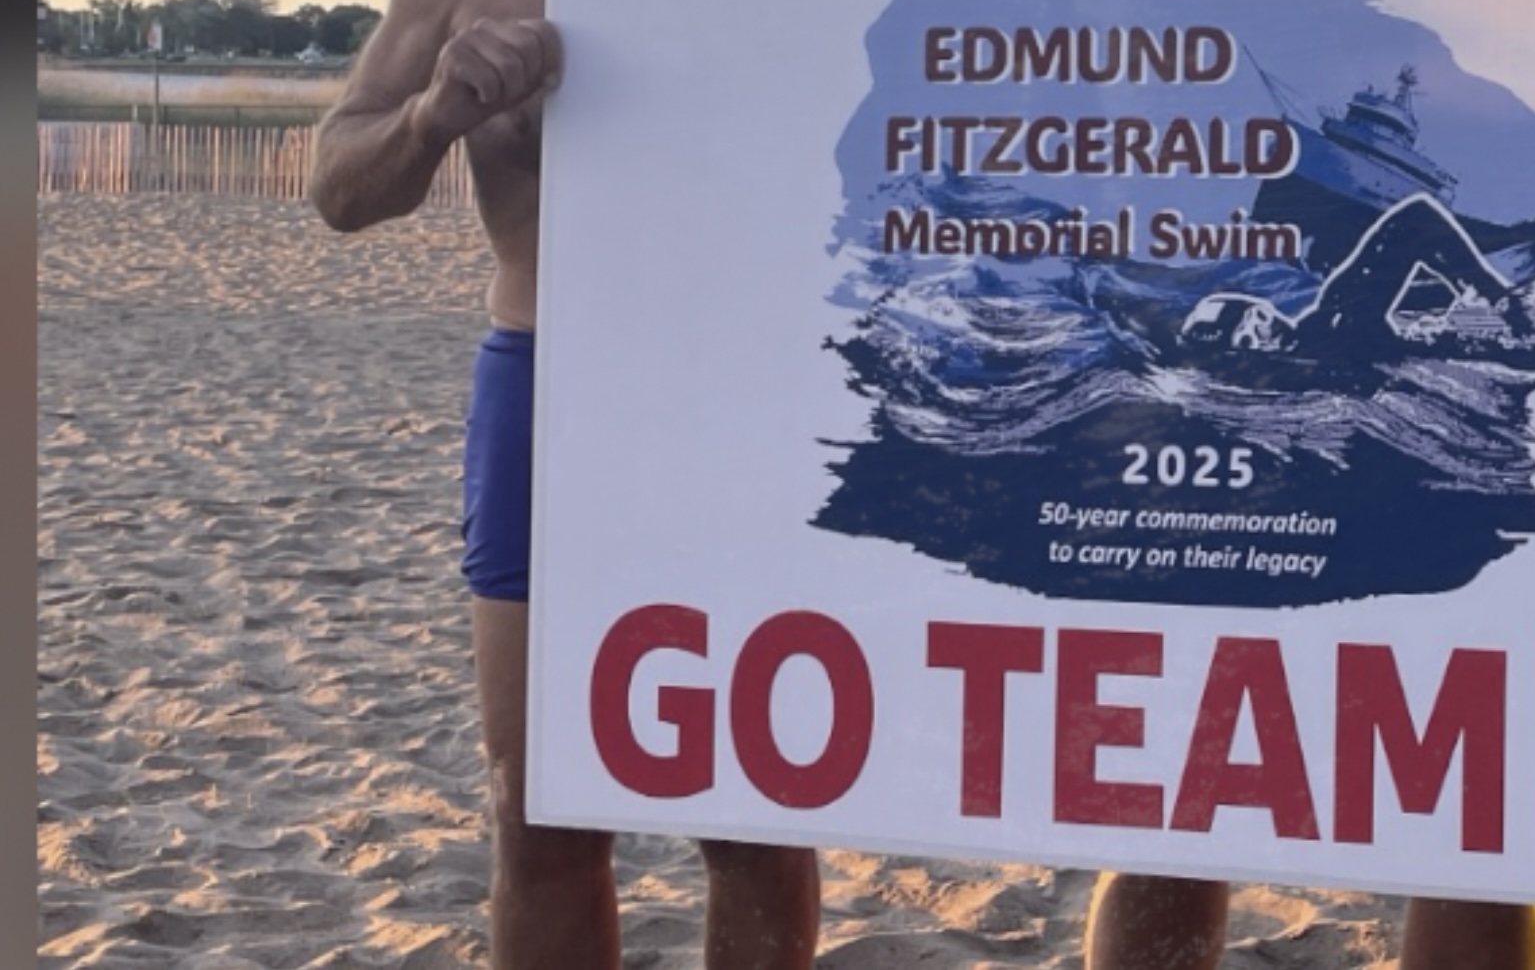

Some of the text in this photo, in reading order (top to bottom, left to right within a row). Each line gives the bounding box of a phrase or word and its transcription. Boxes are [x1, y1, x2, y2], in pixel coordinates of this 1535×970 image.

[923, 26, 1234, 85] EDMUND
[885, 116, 1300, 178] FITZGERALD
[883, 207, 1302, 261] Memorial Swim
[1121, 443, 1255, 489] 2025
[1037, 501, 1337, 536] 50-year commemoration
[1048, 541, 1327, 578] to carry on their legacy
[590, 603, 874, 810] GO
[925, 620, 1508, 855] TEAM
